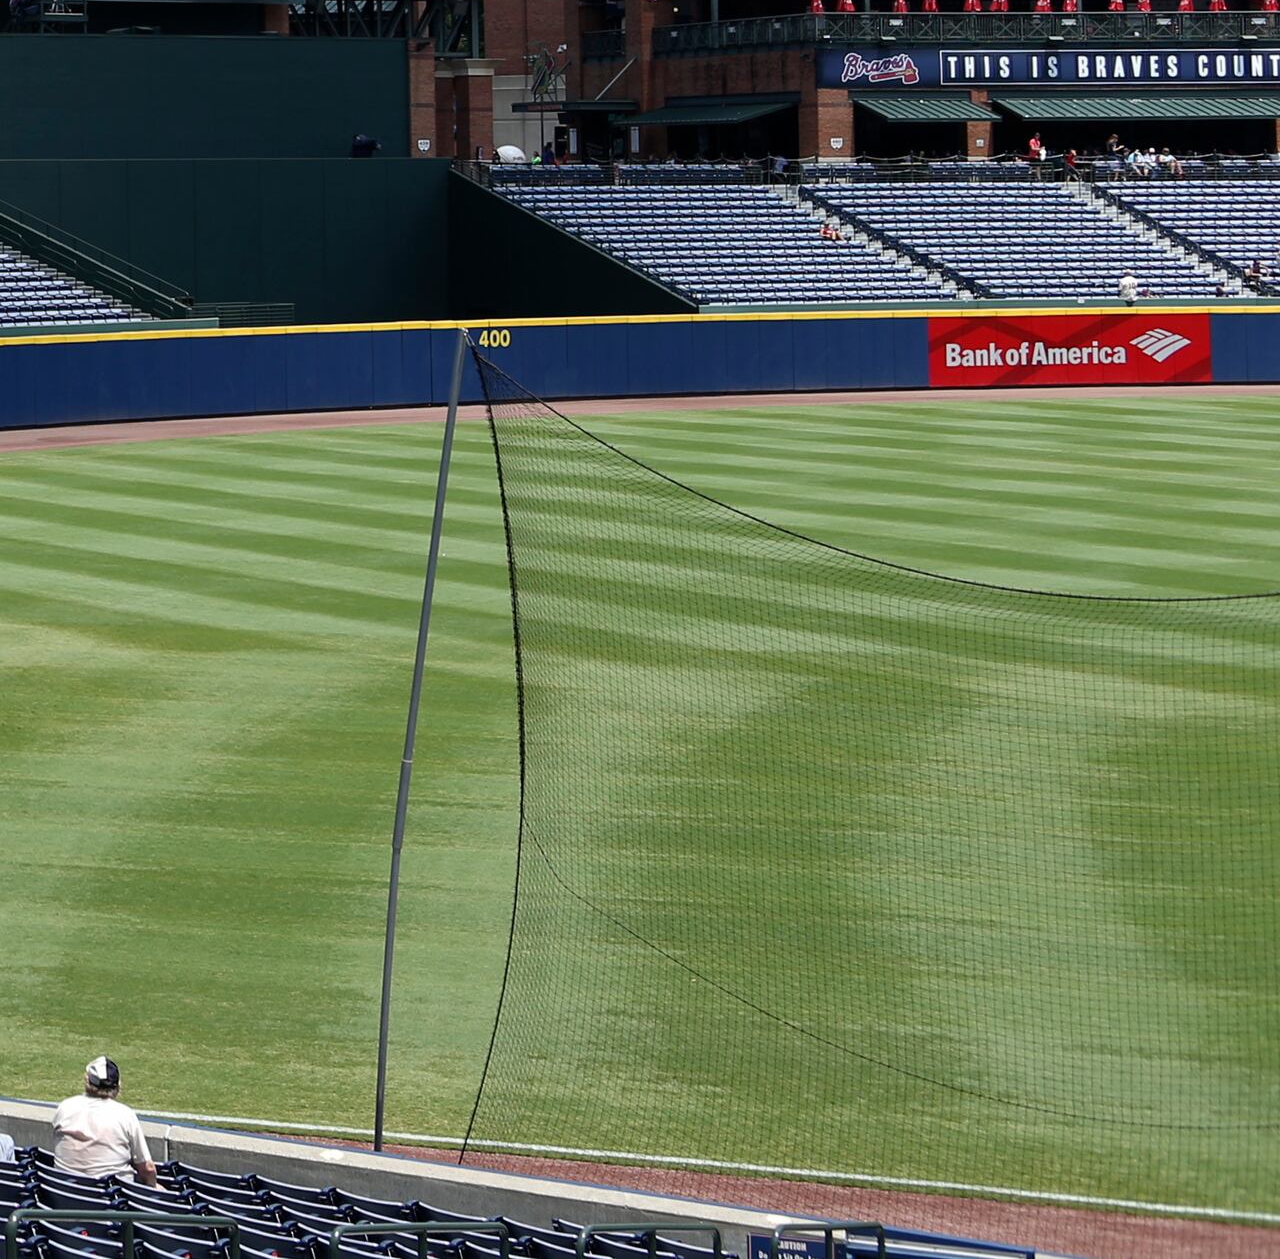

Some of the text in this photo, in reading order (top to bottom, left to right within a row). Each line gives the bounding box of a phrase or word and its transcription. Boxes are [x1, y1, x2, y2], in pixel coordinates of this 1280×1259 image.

[841, 52, 905, 82] Braves
[947, 54, 1280, 79] THIS IS BRAVES COUNT
[478, 329, 511, 348] 400
[946, 341, 1126, 367] Bank of America
